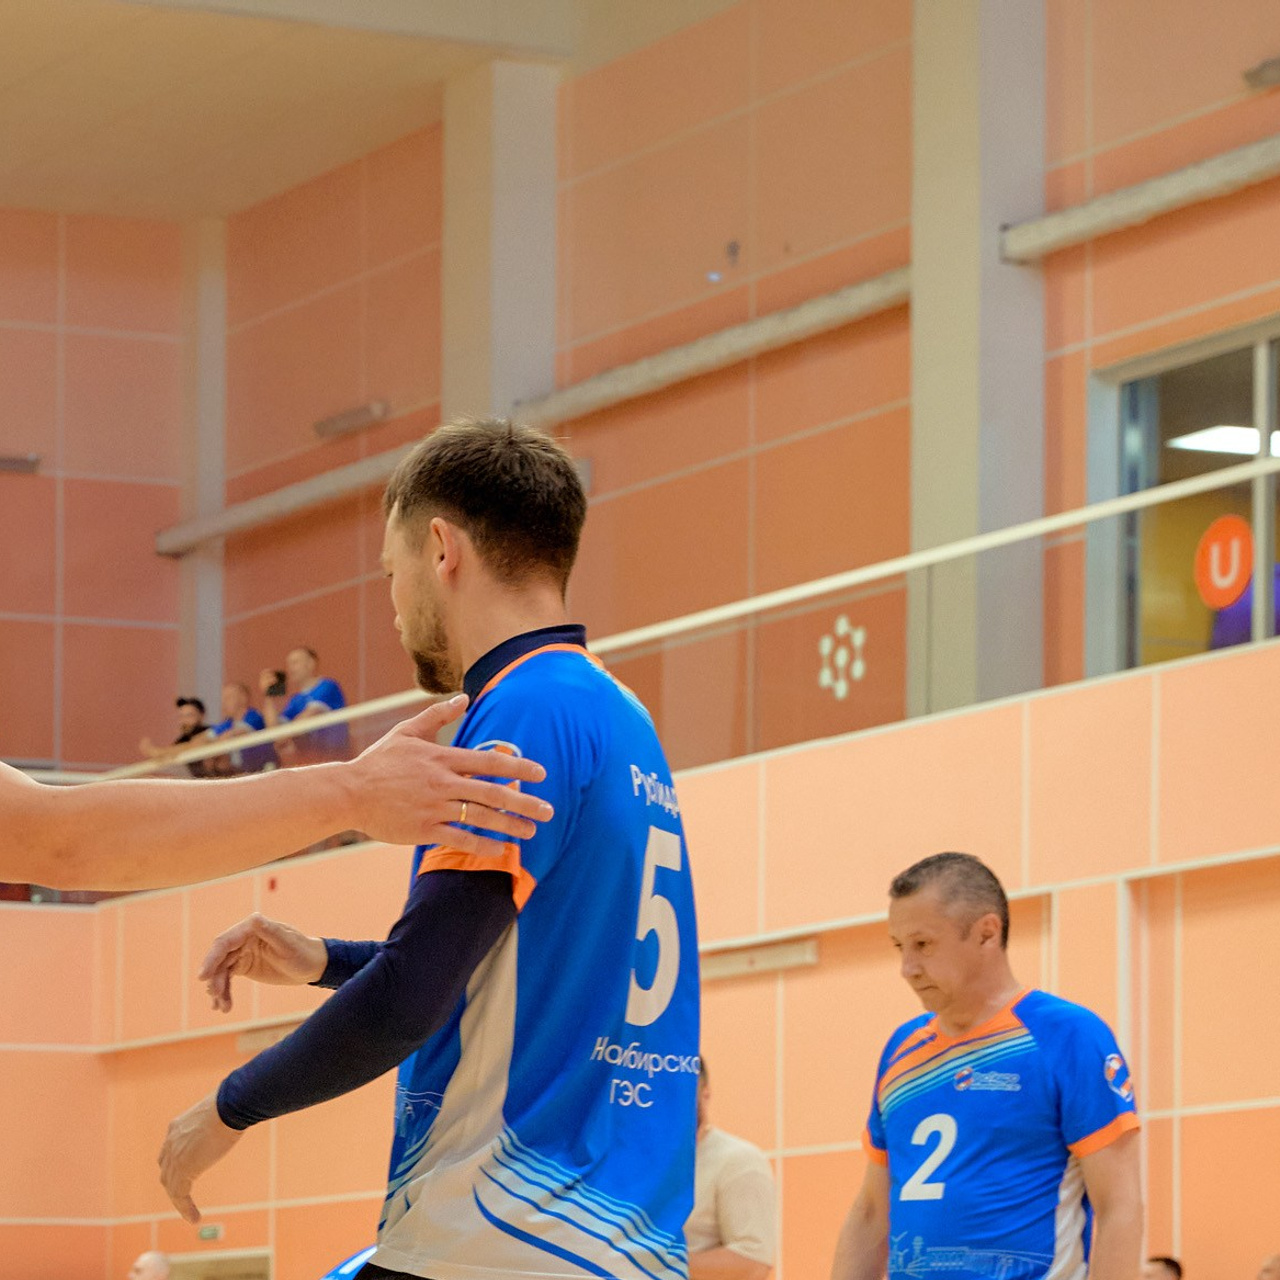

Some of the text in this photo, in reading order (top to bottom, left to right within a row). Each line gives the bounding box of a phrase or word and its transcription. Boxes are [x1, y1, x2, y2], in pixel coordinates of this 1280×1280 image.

[1210, 537, 1240, 588] U
[625, 825, 681, 1027] 5
[609, 1079, 654, 1108] ГЭС
[899, 1114, 958, 1201] 2
